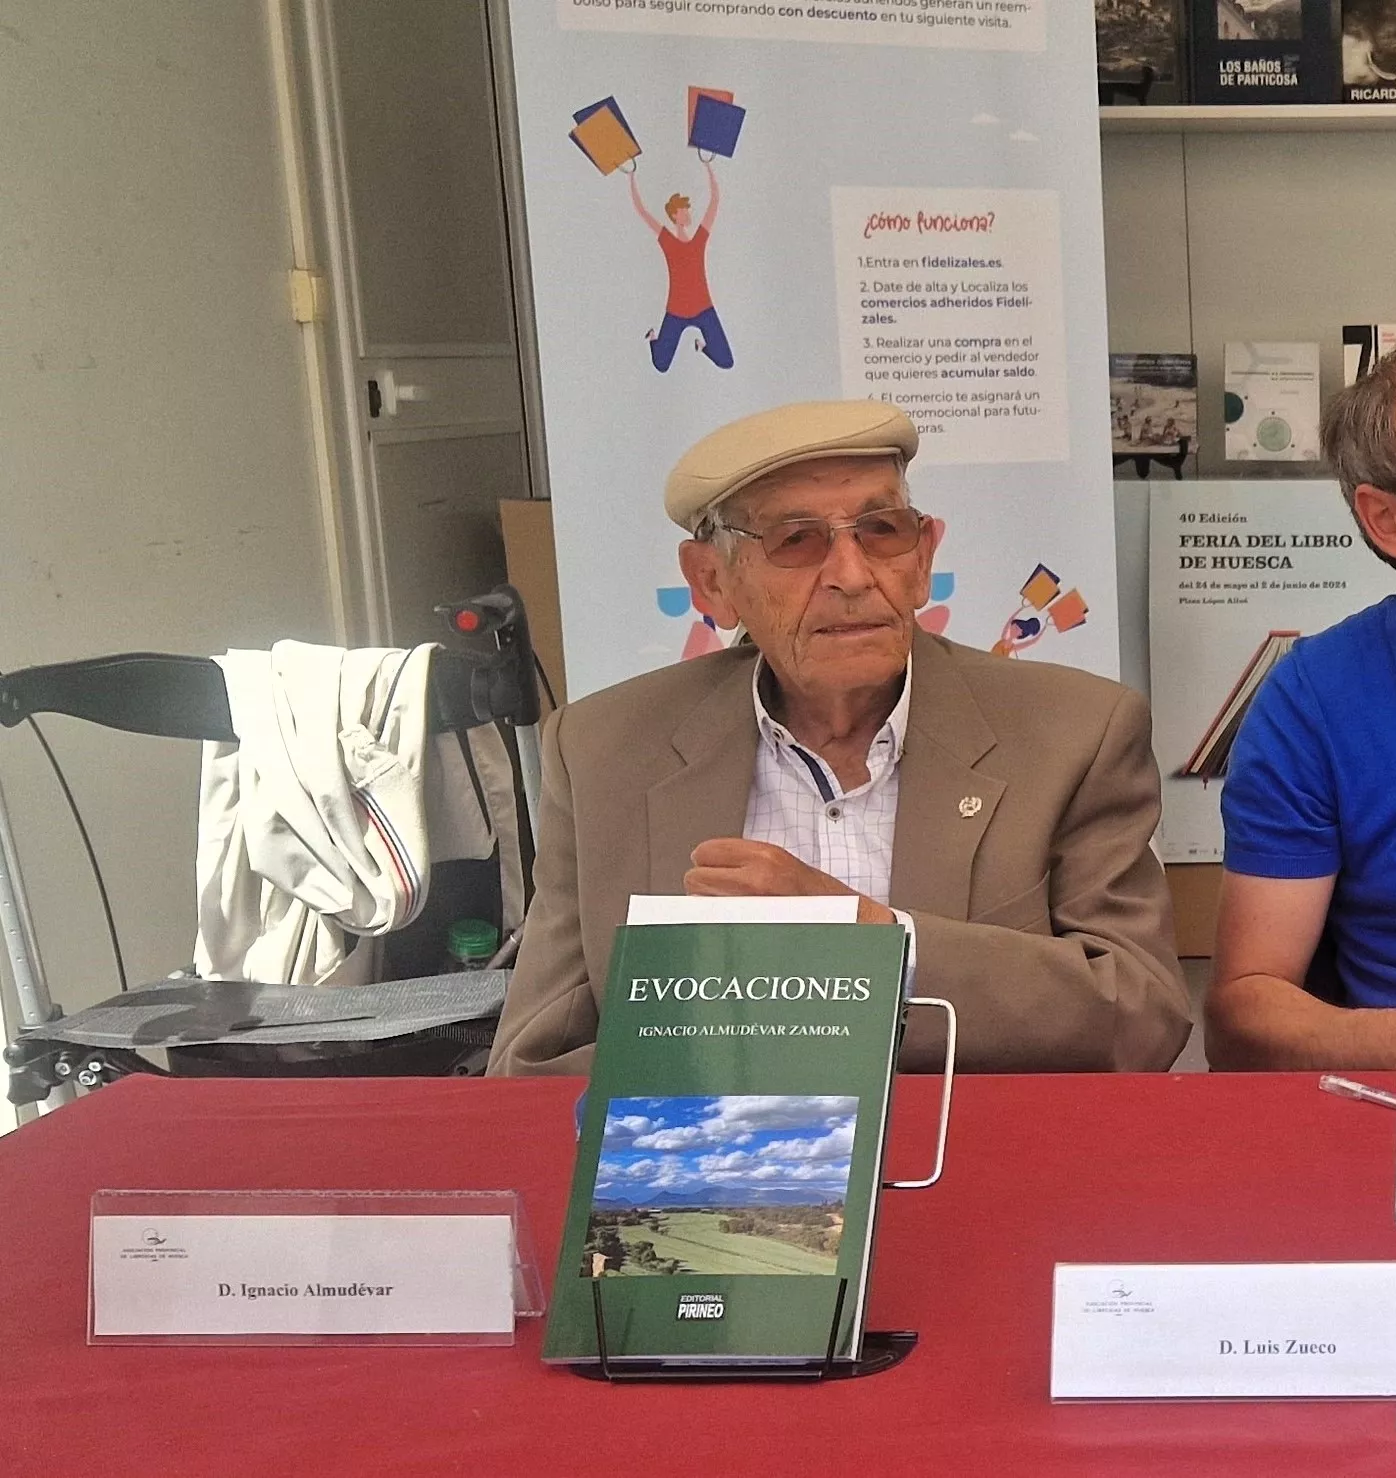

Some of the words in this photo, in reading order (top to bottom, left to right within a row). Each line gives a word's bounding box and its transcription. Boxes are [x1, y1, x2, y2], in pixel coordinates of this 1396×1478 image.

[920, 0, 973, 10] generan
[977, 1, 992, 10] un
[615, 0, 646, 9] para
[649, 0, 690, 13] seguir
[695, 2, 775, 16] comprando
[778, 7, 803, 17] con
[806, 5, 877, 21] descuento
[880, 12, 897, 22] en
[900, 11, 913, 23] tu
[917, 12, 975, 27] siguiente
[978, 15, 1012, 28] visita.
[1219, 60, 1241, 73] LOS
[1243, 58, 1281, 73] BAÑOS
[1220, 74, 1235, 86] DE
[1237, 73, 1298, 86] PANTICOSA
[917, 210, 996, 234] funciona?
[903, 259, 919, 268] en
[873, 281, 903, 293] Date
[906, 281, 921, 292] de
[925, 281, 948, 292] alta
[950, 284, 959, 294] y
[961, 281, 1009, 292] Localiza
[1012, 281, 1028, 291] los
[861, 297, 927, 309] comercios
[930, 296, 993, 308] adheridos
[996, 296, 1032, 308] Fideli-
[862, 313, 897, 324] zales.
[877, 337, 924, 348] Realizar
[928, 339, 950, 348] una
[954, 337, 1001, 349] compra
[1004, 337, 1020, 347] en
[1022, 336, 1033, 346] el
[864, 353, 922, 364] comercio
[924, 354, 933, 365] y
[935, 352, 966, 364] pedir
[970, 352, 980, 362] al
[984, 351, 1039, 362] vendedor
[865, 371, 889, 381] que
[892, 369, 938, 381] quieres
[941, 367, 1000, 378] acumular
[881, 392, 892, 402] El
[896, 390, 953, 403] comercio
[955, 393, 967, 402] te
[971, 390, 1021, 404] asignará
[1025, 392, 1040, 400] un
[984, 407, 1010, 418] para
[1012, 405, 1041, 416] futu-
[1179, 513, 1196, 523] 40
[1199, 513, 1248, 523] Edición
[1179, 535, 1242, 548] FERIA
[1247, 534, 1286, 548] DEL
[1290, 534, 1353, 548] LIBRO
[1179, 556, 1206, 569] DE
[1210, 556, 1293, 569] HUESCA
[1179, 581, 1193, 589] del
[1210, 581, 1221, 589] de
[1223, 582, 1248, 591] mayo
[1269, 581, 1281, 589] de
[1282, 581, 1307, 590] junio
[1309, 581, 1320, 589] de
[1322, 581, 1347, 589] 2024
[628, 976, 872, 1002] EVOCACIONES
[638, 1025, 697, 1037] IGNACIO
[699, 1022, 786, 1037] ALMUDÉVAR
[789, 1024, 850, 1036] ZAMORA
[218, 1283, 236, 1297] D.
[241, 1282, 299, 1300] Ignacio
[303, 1282, 395, 1298] Almudévar
[680, 1294, 724, 1303] EDITORIAL
[677, 1303, 724, 1319] PIRINEO
[1219, 1340, 1237, 1355] D.
[1243, 1339, 1280, 1355] Luis
[1285, 1339, 1337, 1355] Zueco
